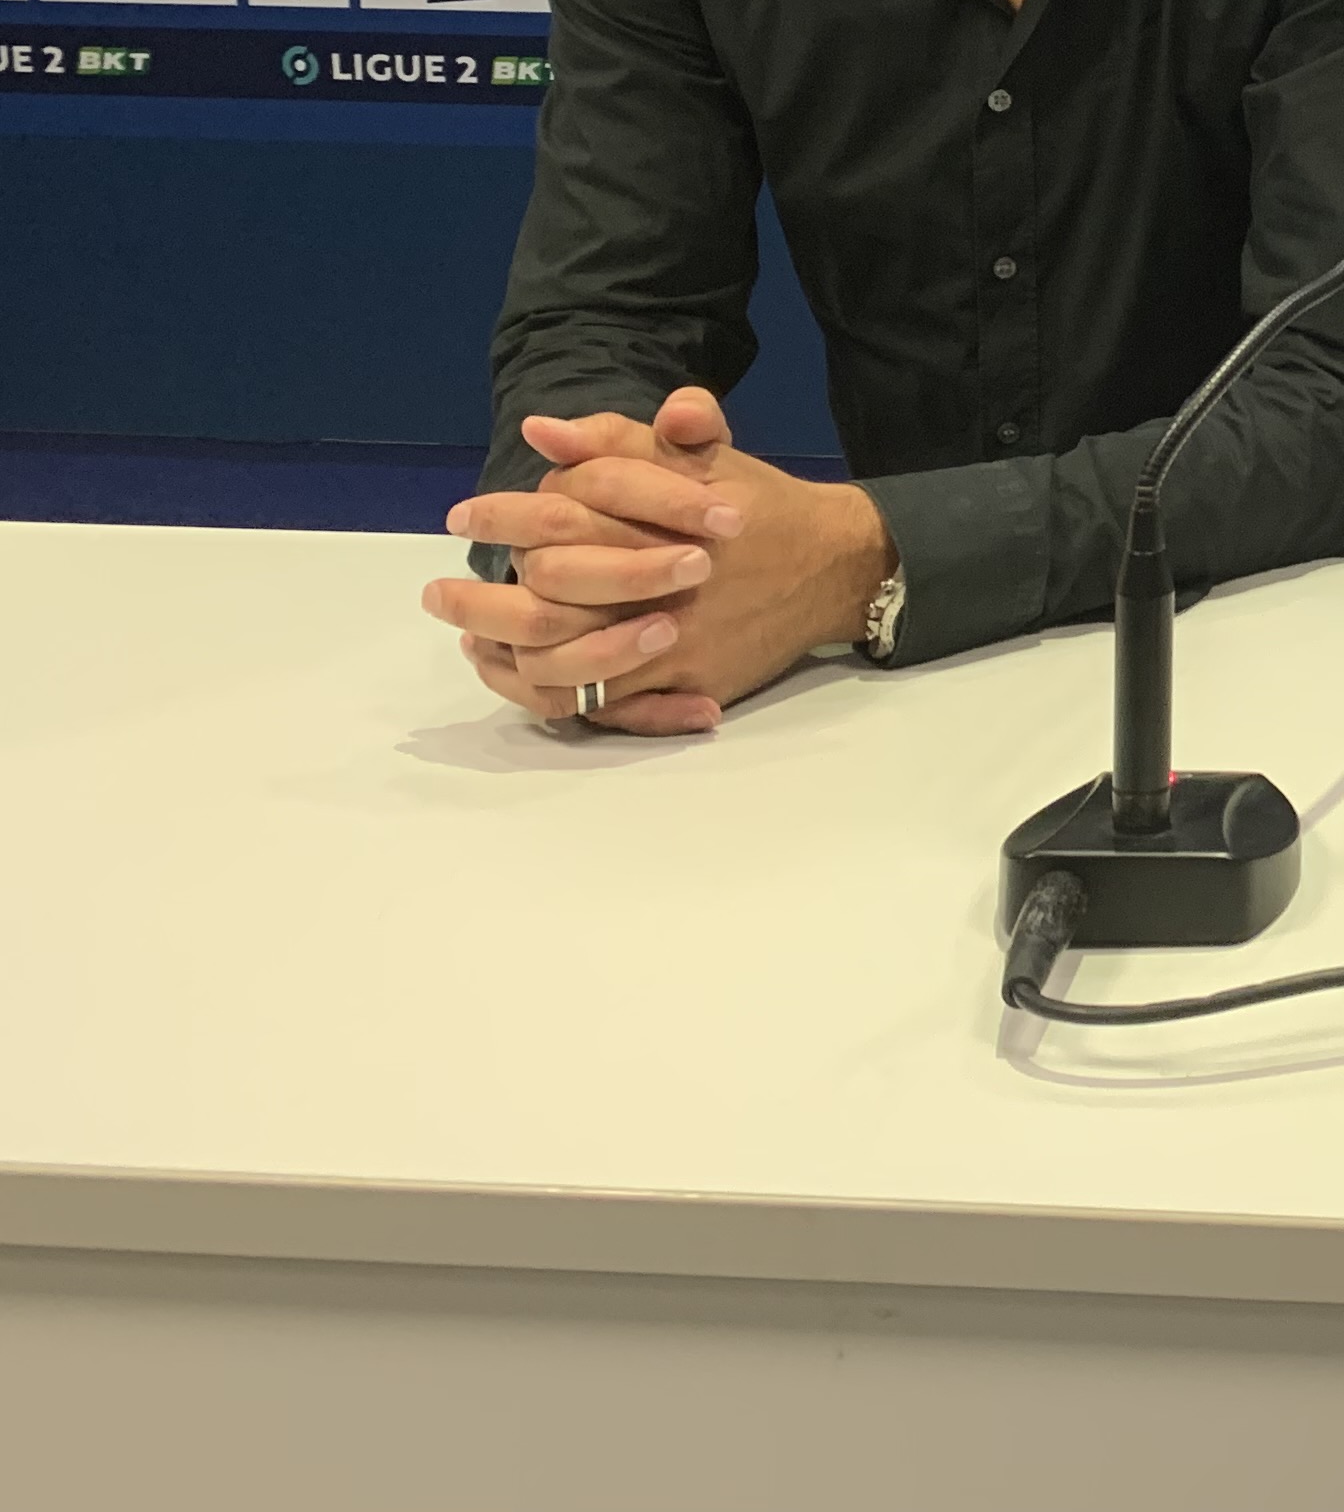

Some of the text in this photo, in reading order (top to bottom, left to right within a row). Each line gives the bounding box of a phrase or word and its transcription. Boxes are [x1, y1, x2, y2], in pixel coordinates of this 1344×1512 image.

[43, 46, 65, 73] 2
[79, 52, 150, 71] BKT
[331, 54, 478, 83] LIGUE 2
